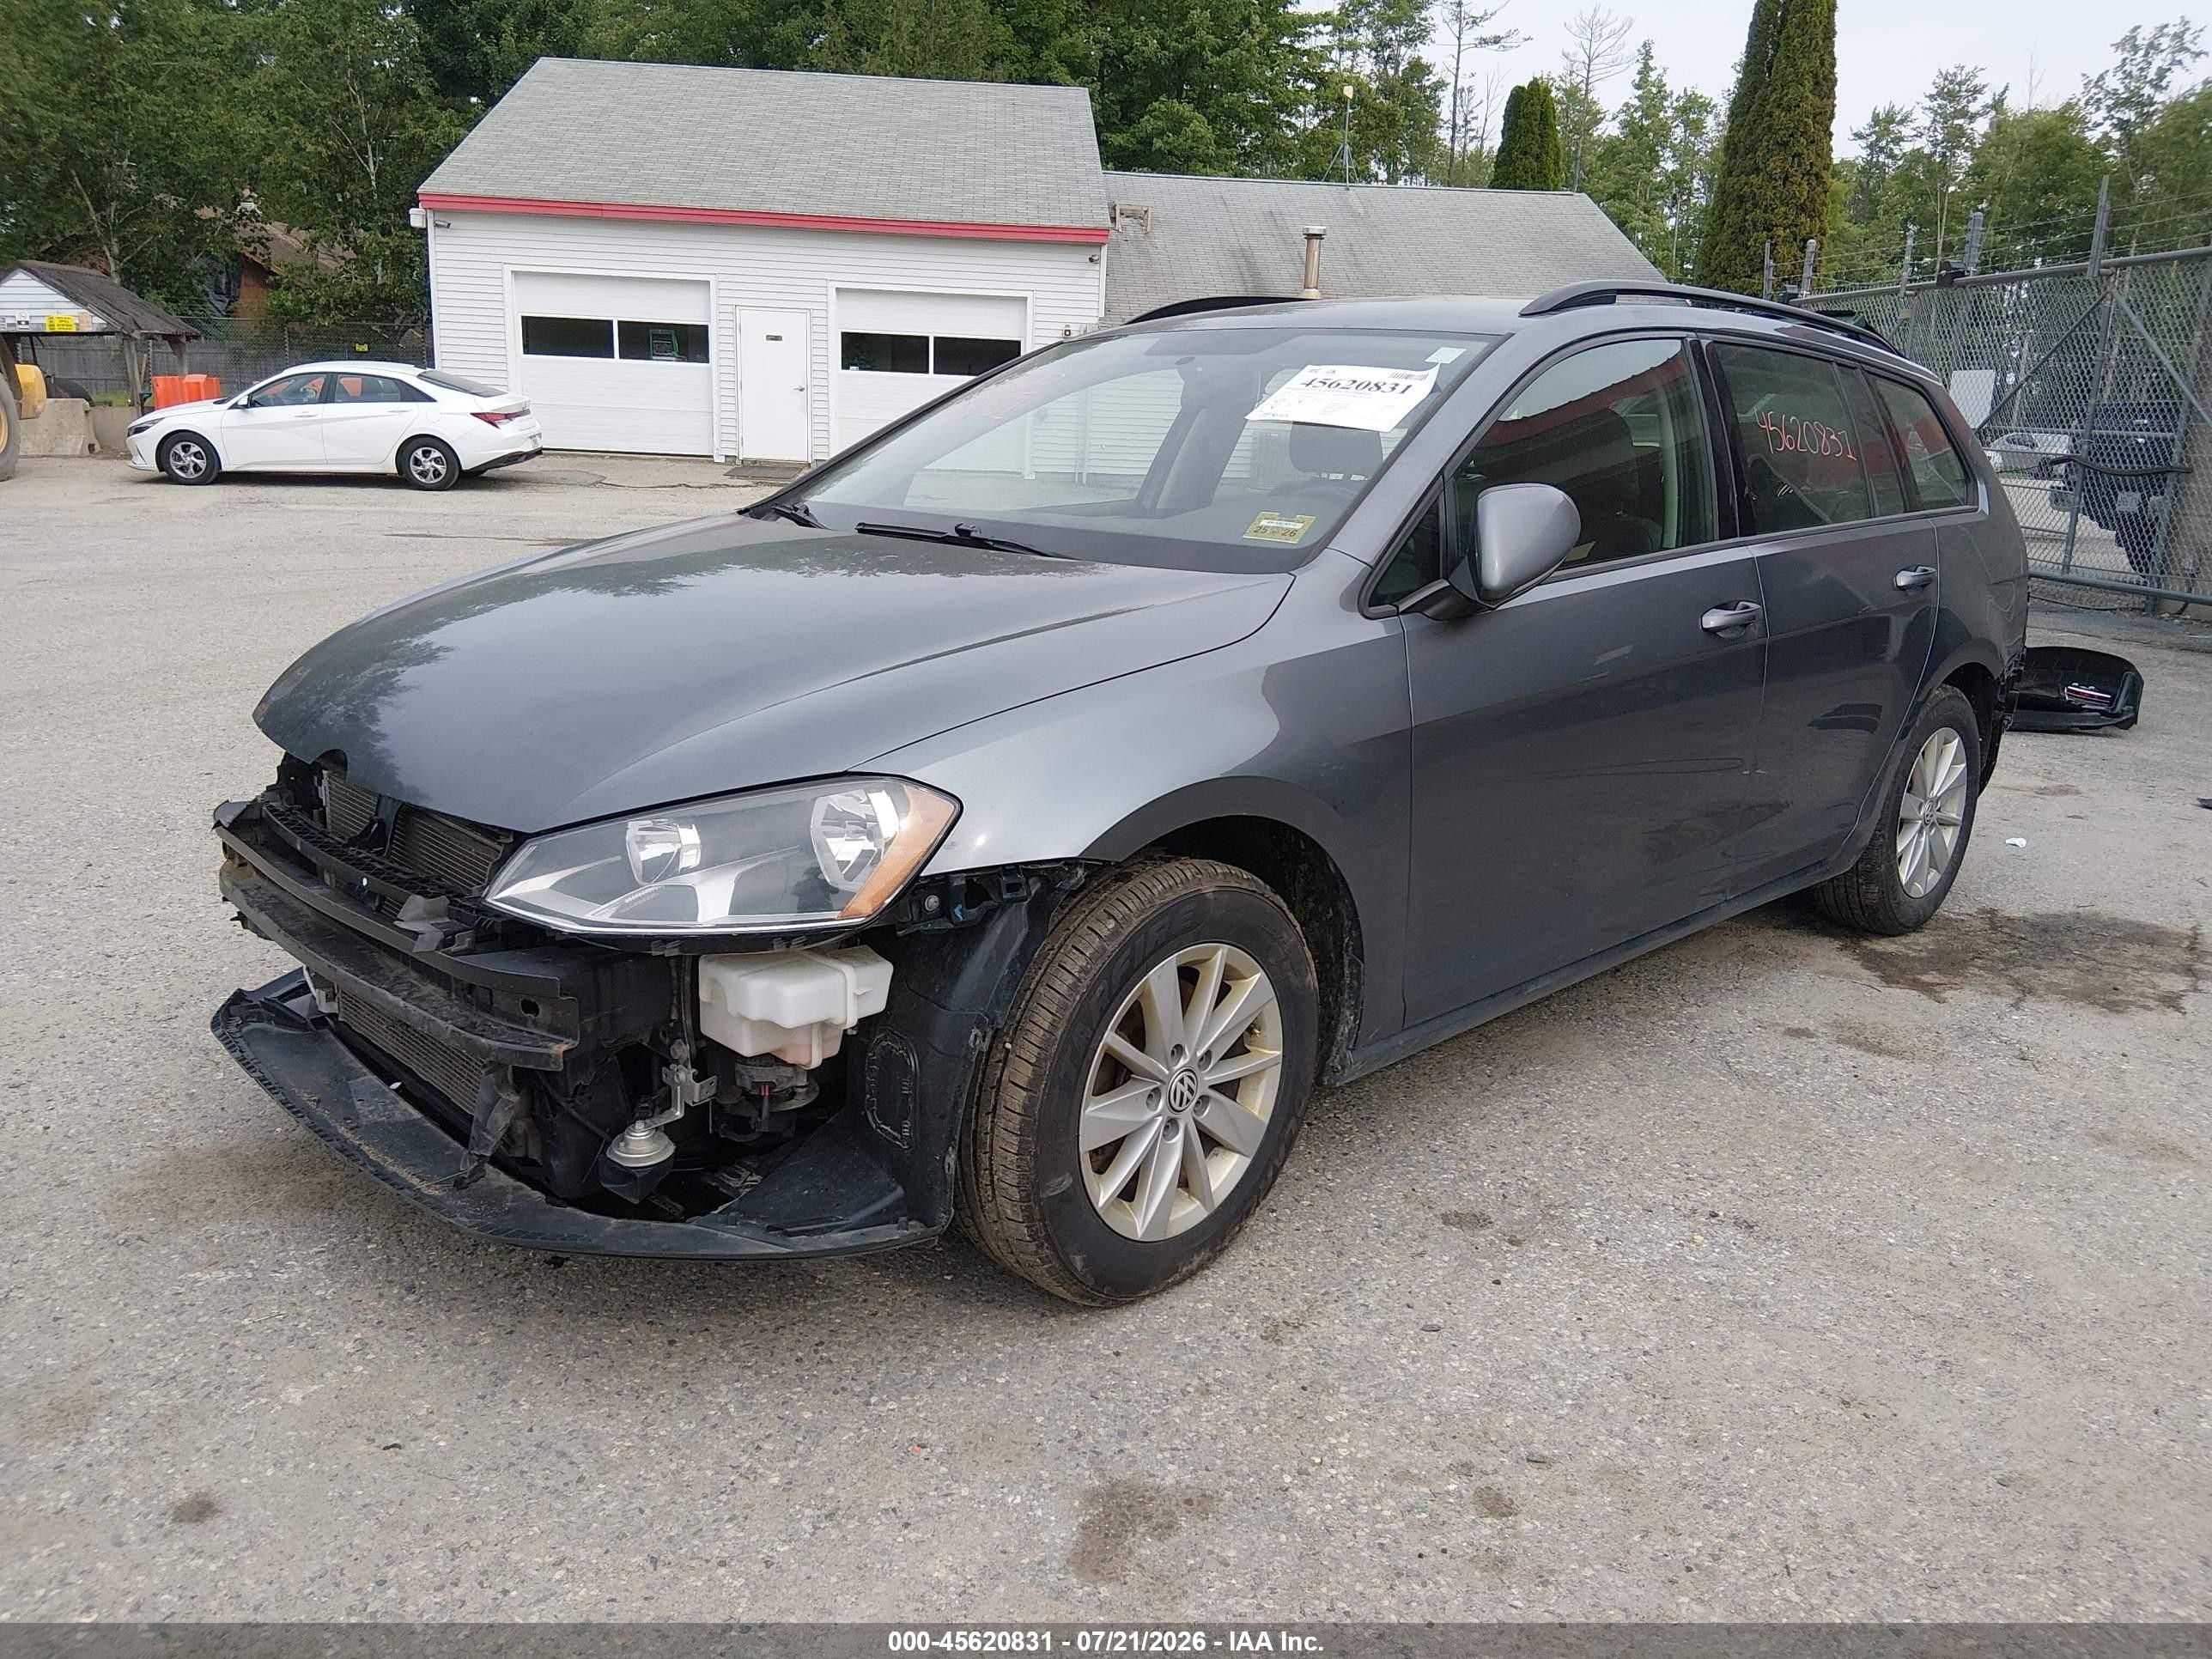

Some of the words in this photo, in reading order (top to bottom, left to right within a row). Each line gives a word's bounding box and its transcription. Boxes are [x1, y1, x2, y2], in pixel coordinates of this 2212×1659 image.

[1300, 377, 1413, 394] 45620831
[1753, 407, 1857, 461] 45620831
[1253, 526, 1268, 534] 25
[1280, 528, 1298, 538] 26
